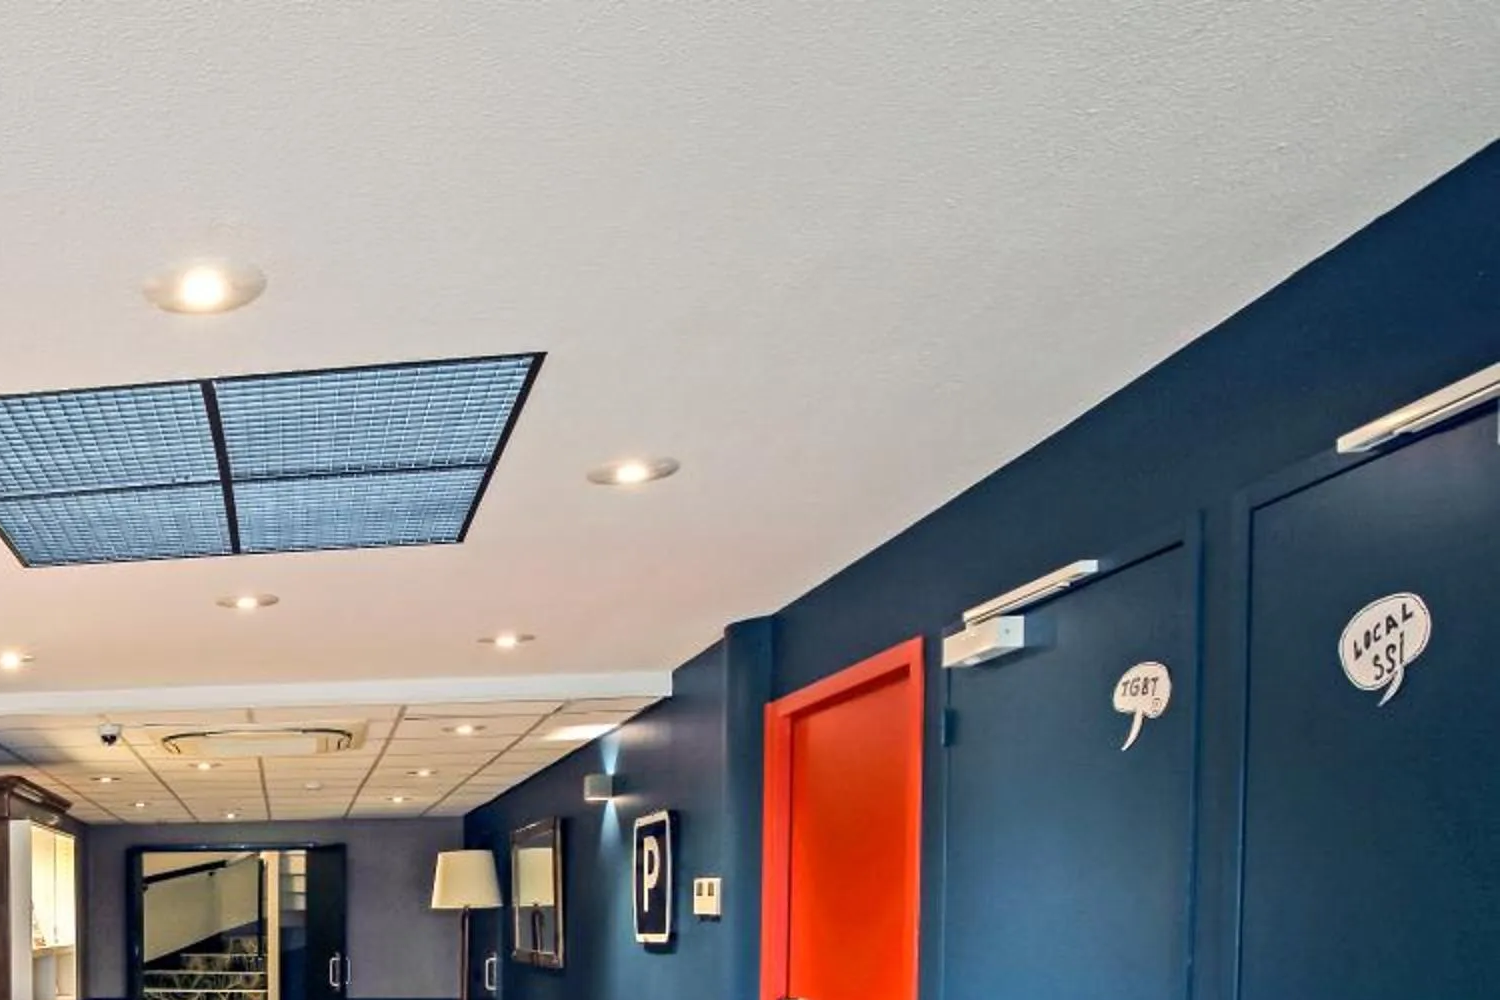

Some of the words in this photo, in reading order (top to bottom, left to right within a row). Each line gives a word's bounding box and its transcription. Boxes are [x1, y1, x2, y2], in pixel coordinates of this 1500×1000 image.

[1353, 603, 1414, 661] LOCAL
[1121, 676, 1159, 697] TGBT
[643, 835, 661, 912] P
